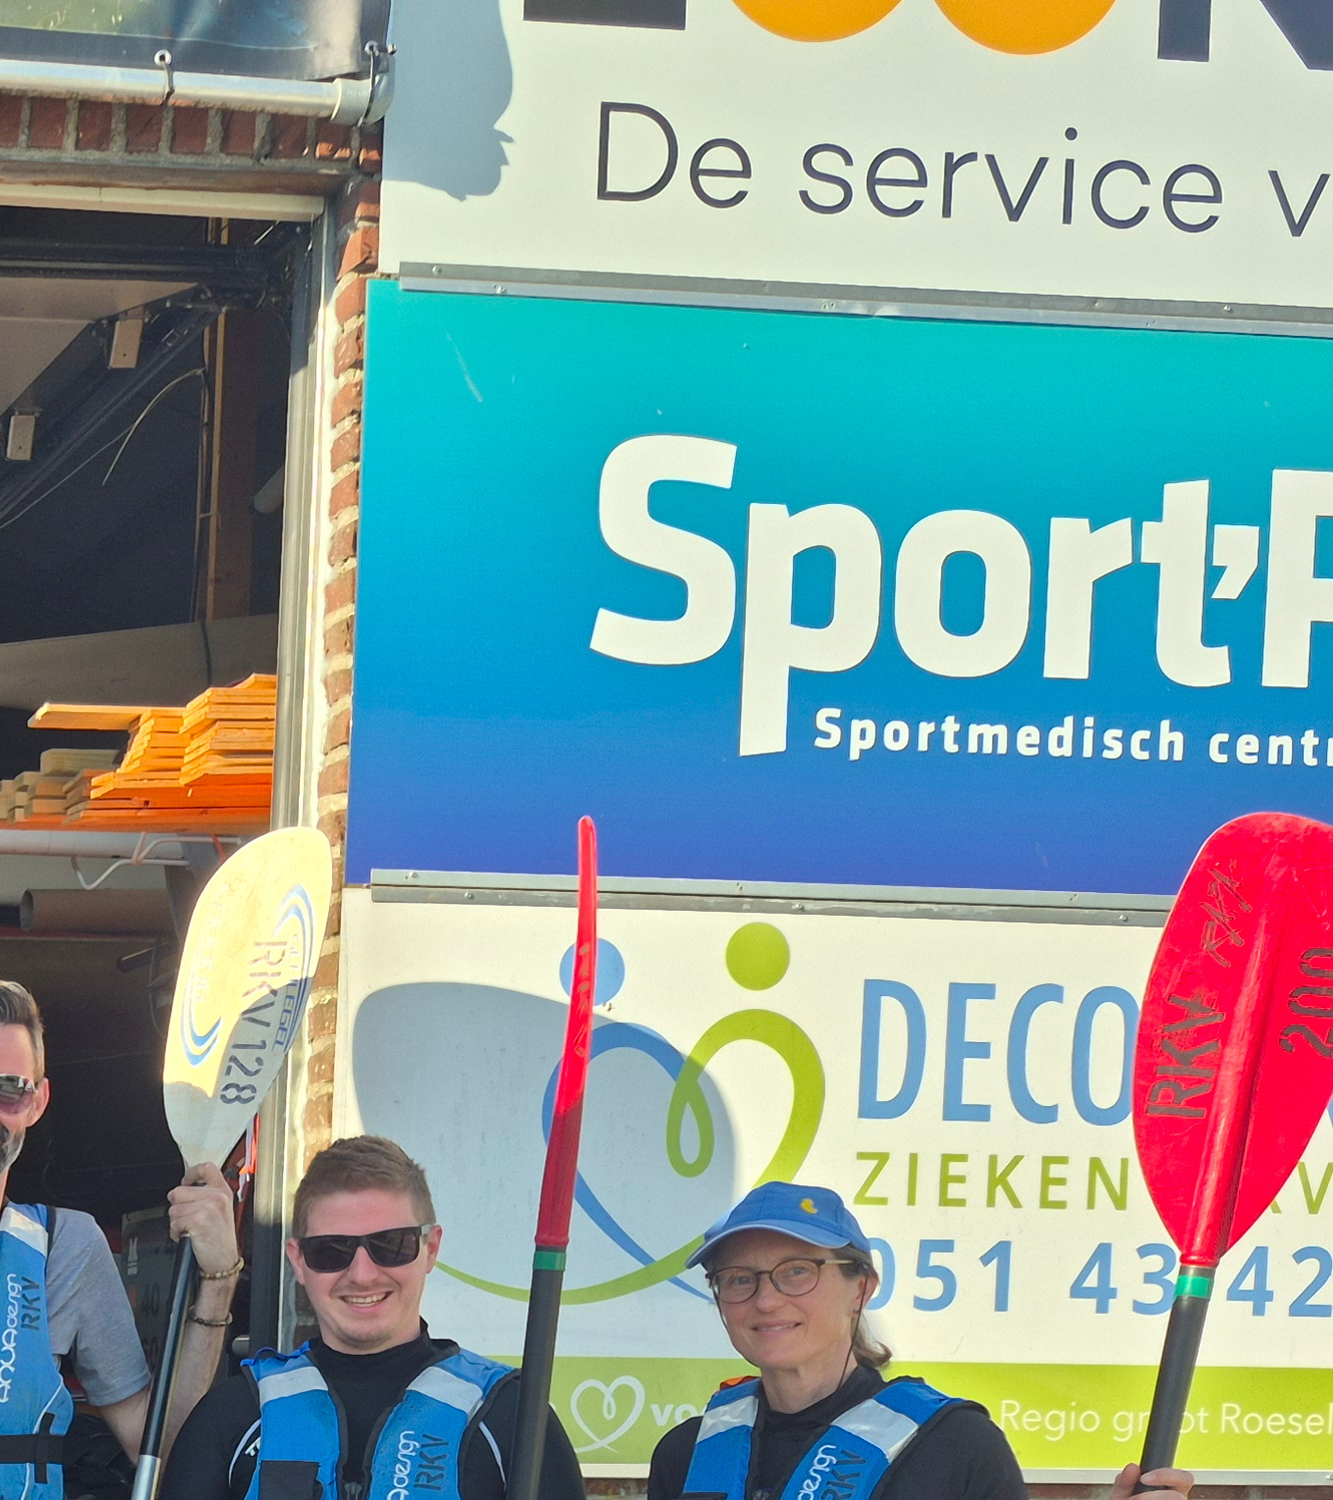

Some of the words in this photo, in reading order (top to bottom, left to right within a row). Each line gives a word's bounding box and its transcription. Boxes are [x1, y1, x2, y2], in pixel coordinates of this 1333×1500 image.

[596, 101, 753, 209] De
[797, 126, 1223, 234] service
[813, 706, 1185, 761] Sportmedisch
[241, 940, 288, 1029] RKV
[219, 1038, 268, 1106] 128
[857, 977, 1333, 1128] DECO
[1145, 992, 1225, 1119] RKV
[20, 1276, 41, 1332] RKV
[1068, 1241, 1179, 1316] 43
[1226, 1245, 1333, 1318] 42
[1000, 1399, 1101, 1441] Regio
[1112, 1401, 1210, 1442] grot
[414, 1433, 450, 1491] RKV
